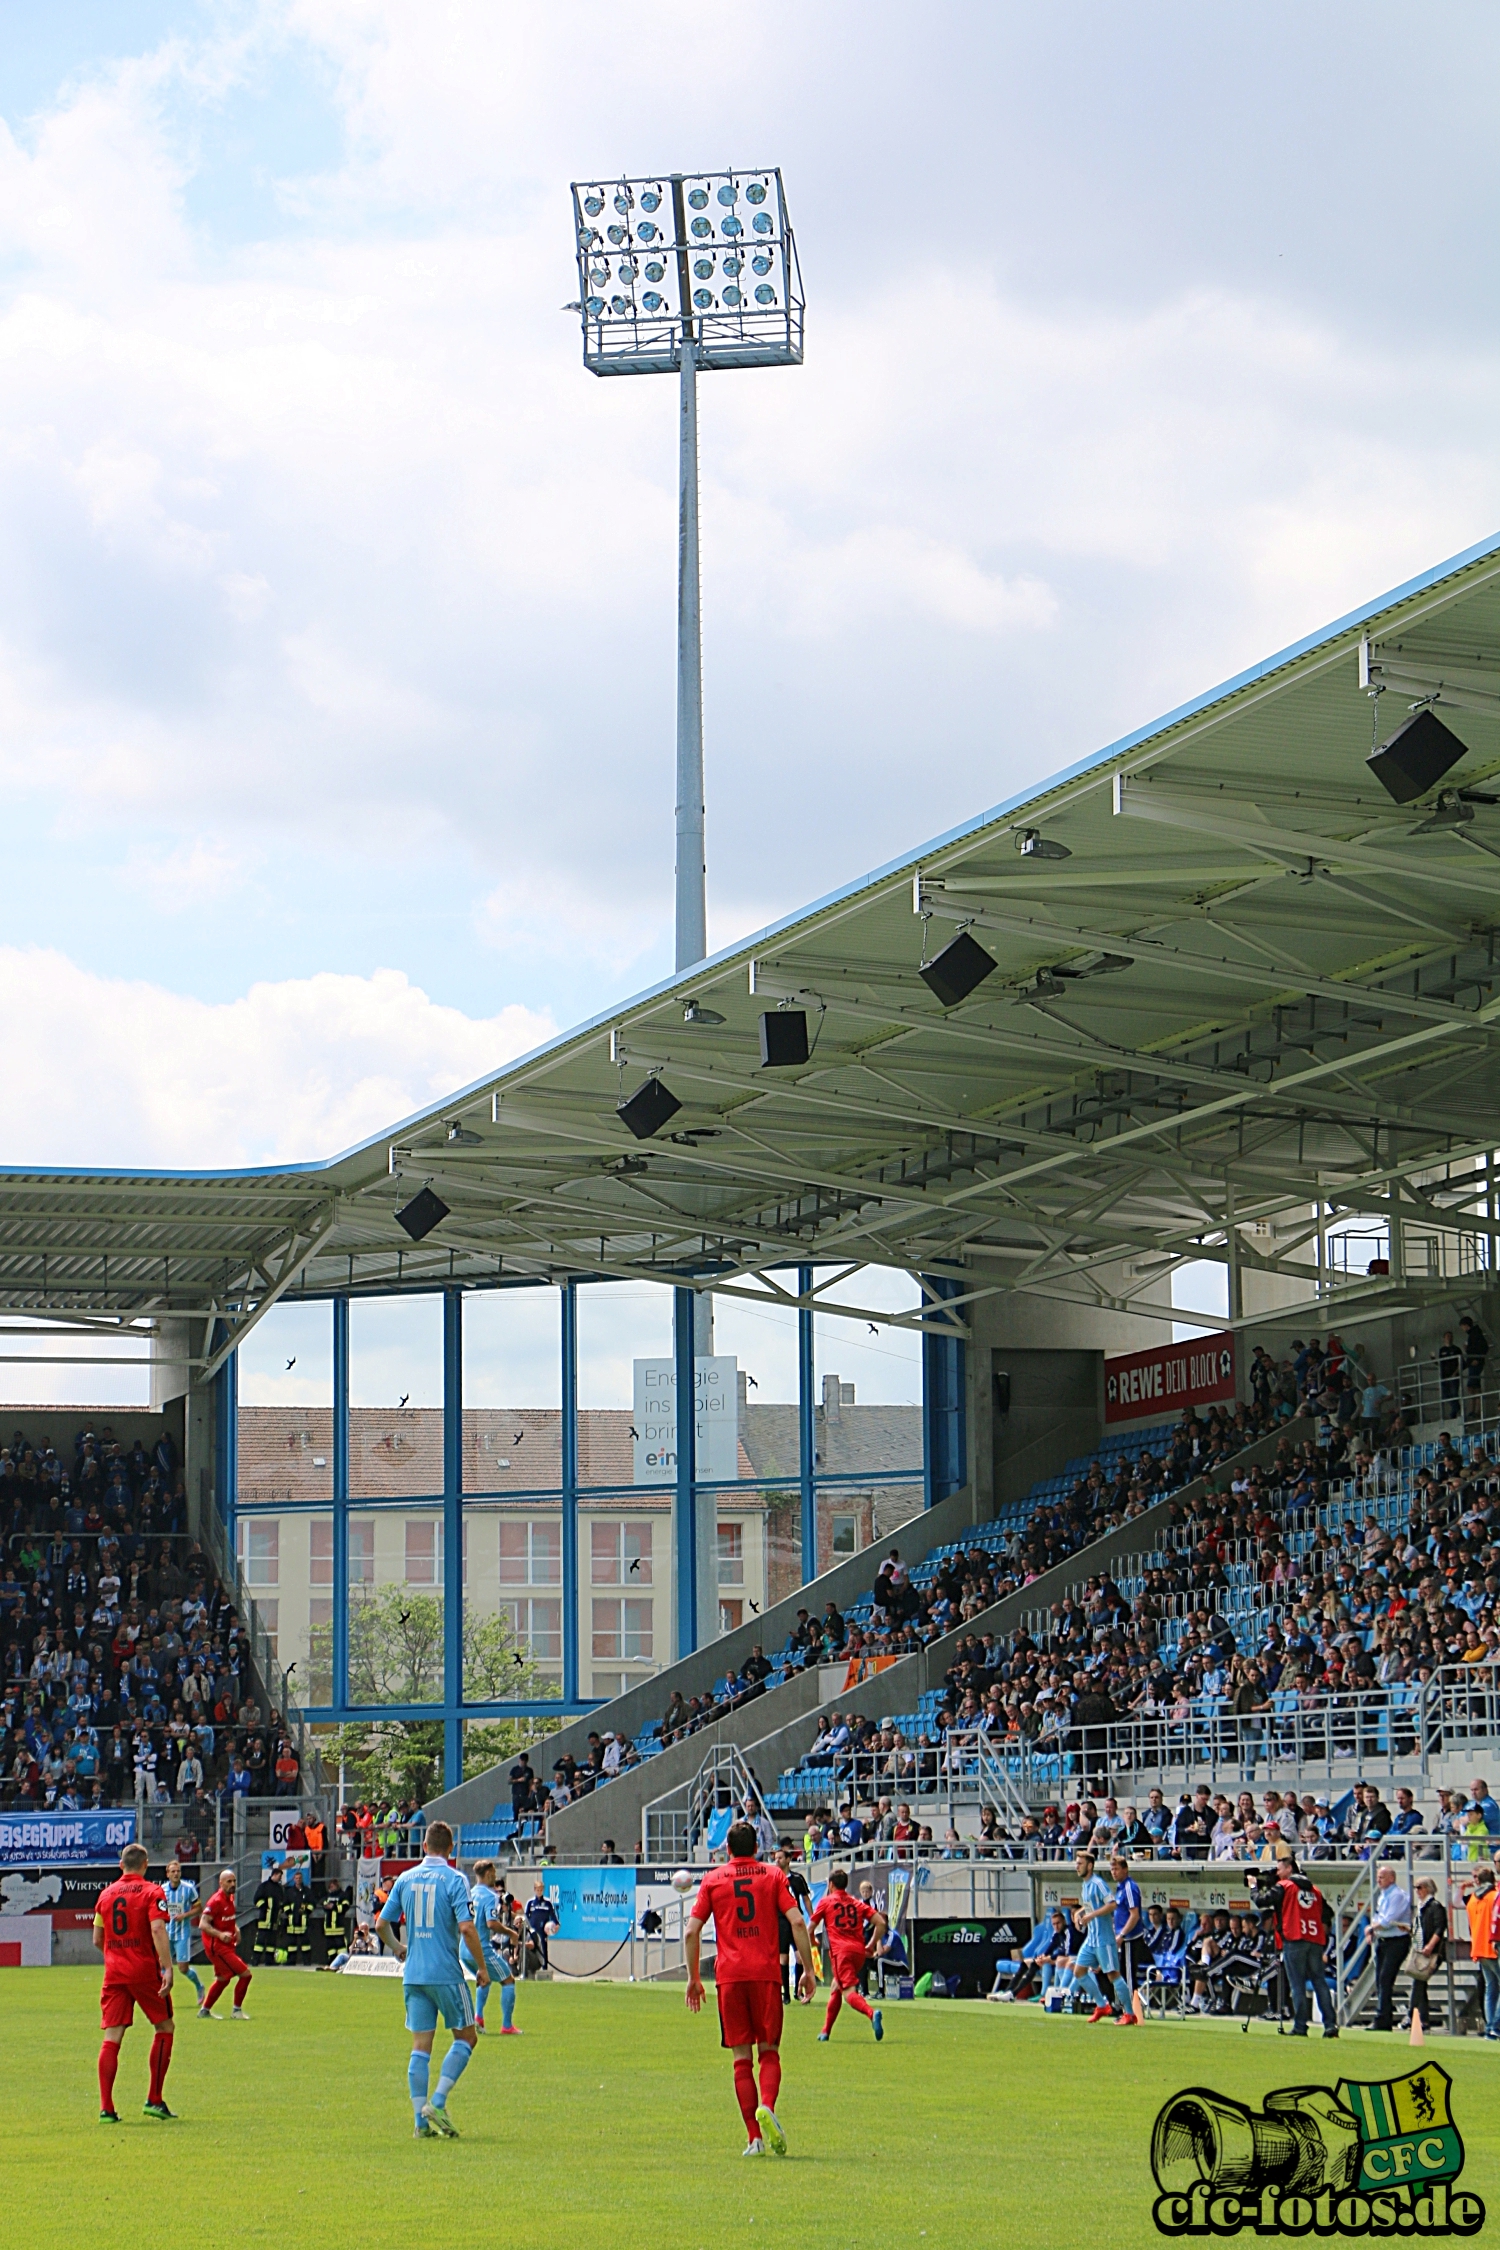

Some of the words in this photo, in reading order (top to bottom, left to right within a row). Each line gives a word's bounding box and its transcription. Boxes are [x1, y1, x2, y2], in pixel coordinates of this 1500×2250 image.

[645, 1367, 719, 1389] Enegie
[1119, 1363, 1164, 1405] REWE
[1165, 1358, 1188, 1395] DEIN
[1190, 1351, 1219, 1390] BLOCK
[645, 1396, 671, 1413] ins
[645, 1447, 678, 1467] ein
[645, 1468, 673, 1476] energie
[106, 1820, 132, 1846] OST
[736, 1866, 767, 1877] HANSA
[411, 1883, 437, 1928] 11
[582, 1890, 628, 1908] www.m2-group.de
[733, 1878, 756, 1923] 5
[1152, 1888, 1167, 1904] eins
[1210, 1888, 1226, 1905] eins
[112, 1896, 127, 1935] 6
[833, 1902, 858, 1928] 29
[736, 1926, 760, 1938] HENN
[922, 1932, 981, 1943] EASTSIDE
[991, 1935, 1017, 1943] adidas
